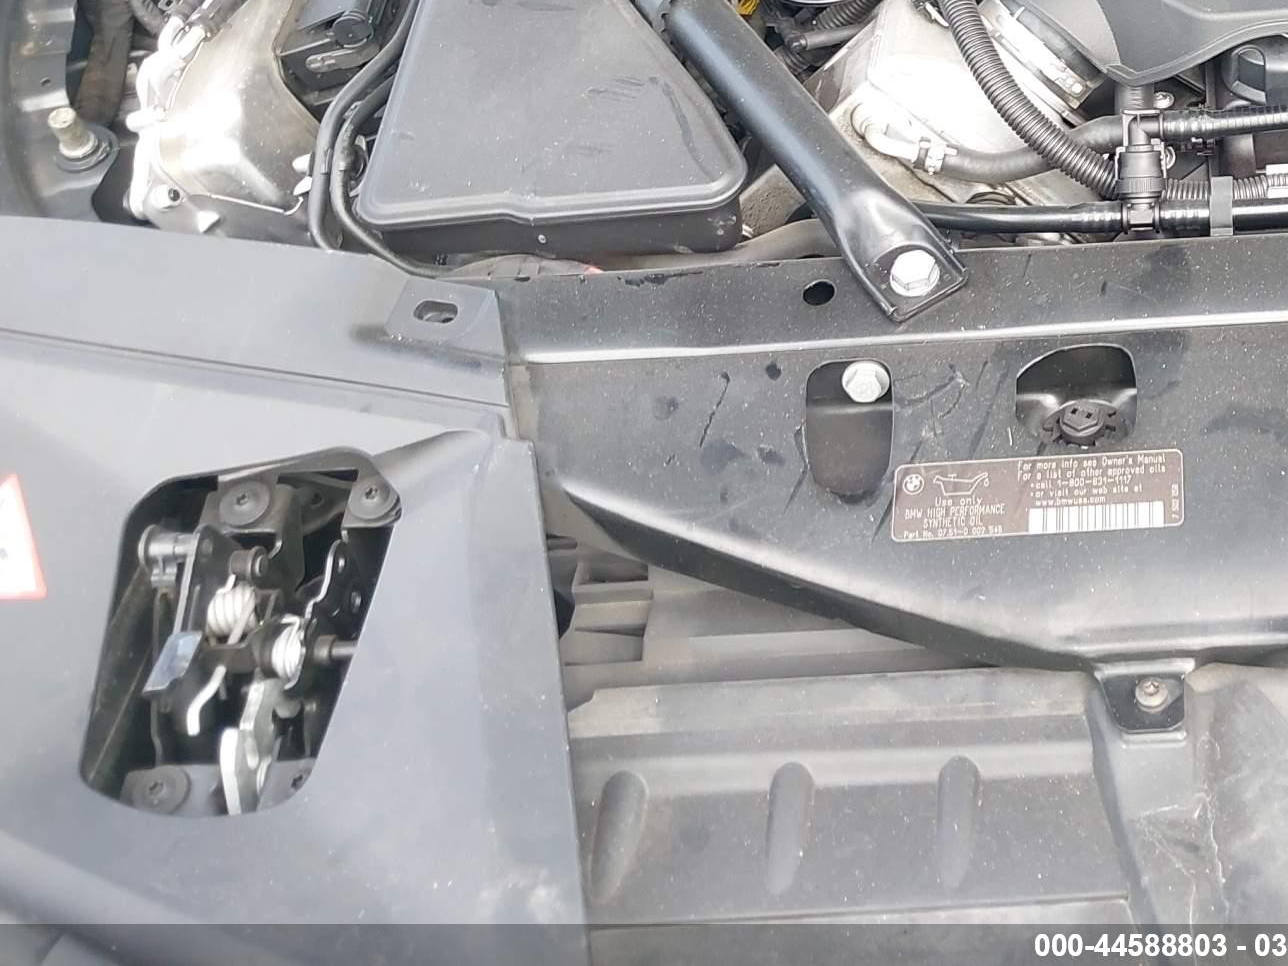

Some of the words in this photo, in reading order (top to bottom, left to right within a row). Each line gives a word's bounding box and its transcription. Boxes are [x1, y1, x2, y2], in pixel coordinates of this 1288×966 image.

[1017, 460, 1032, 471] For
[1036, 462, 1057, 470] more
[1083, 459, 1097, 468] see
[1101, 455, 1133, 466] Owner's
[1137, 453, 1166, 464] Manual
[1017, 470, 1032, 481] For
[1046, 468, 1061, 479] list
[1066, 468, 1076, 478] of
[1081, 466, 1102, 477] other
[1107, 464, 1145, 476] approved
[1149, 464, 1166, 474] oils
[1035, 480, 1052, 489] call
[1049, 487, 1069, 497] visit
[1073, 488, 1087, 496] our
[1092, 485, 1108, 495] web
[935, 496, 953, 507] Use
[960, 494, 983, 506] only
[1035, 496, 1106, 506] www.bmwusa.com
[904, 508, 923, 520] BMW
[927, 507, 946, 517] HIGH
[949, 503, 1006, 516] PERFORMANCE
[923, 516, 966, 529] SYNTHETIC
[969, 514, 983, 526] OIL
[903, 529, 919, 539] Part
